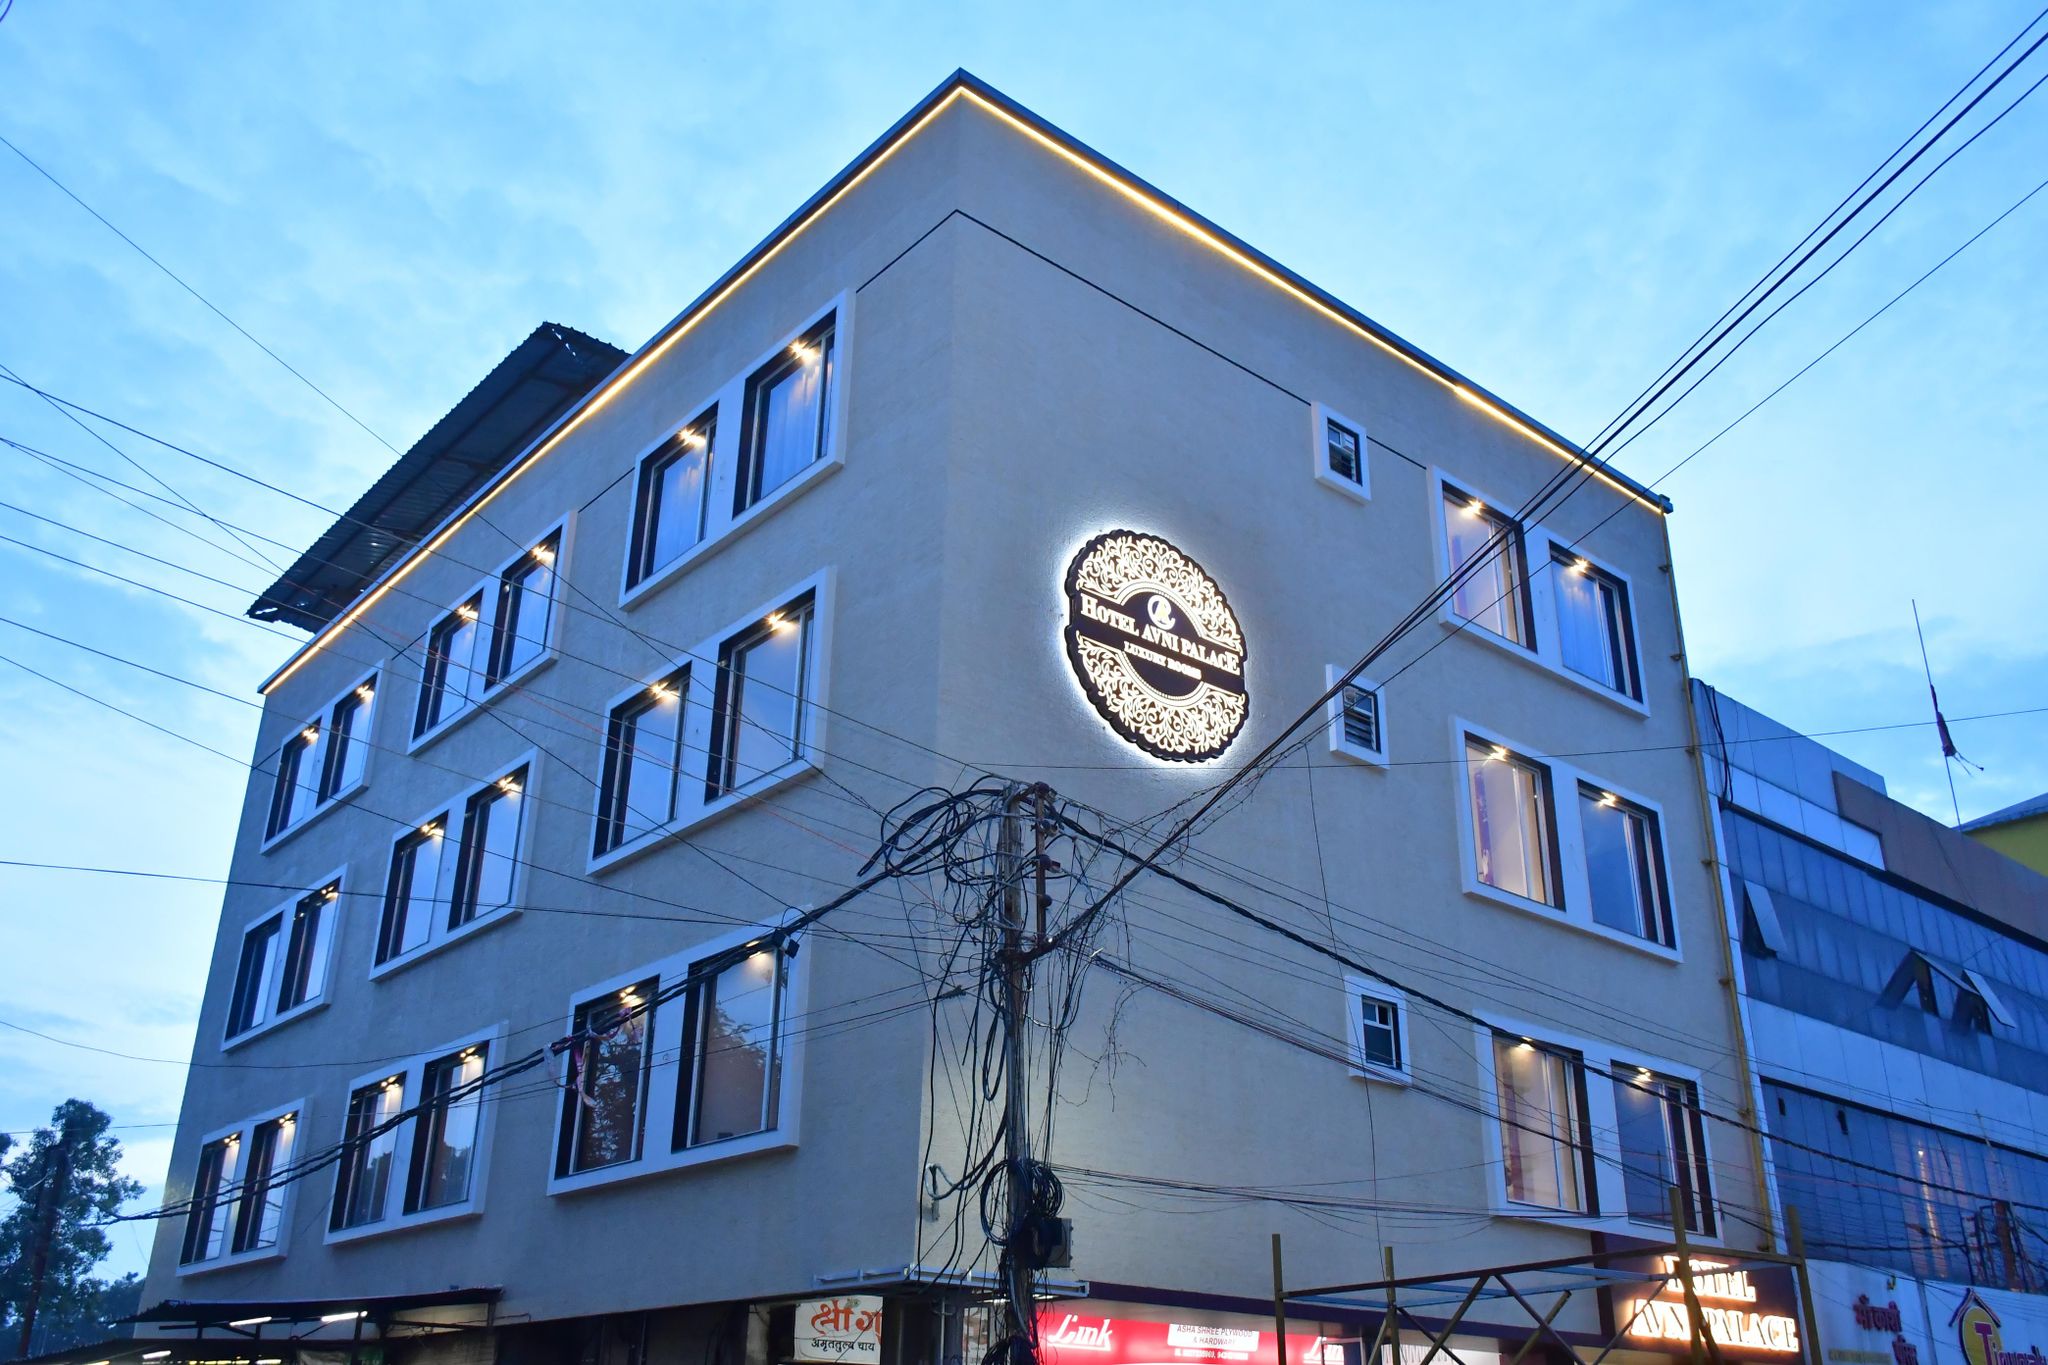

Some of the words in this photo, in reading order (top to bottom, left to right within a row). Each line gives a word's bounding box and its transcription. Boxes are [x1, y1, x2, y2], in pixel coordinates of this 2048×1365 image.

[1080, 592, 1140, 636] HOTEL
[1142, 624, 1180, 653] AVNI
[1180, 637, 1241, 676] PALACE
[1123, 640, 1167, 667] LUXURY
[1167, 657, 1202, 680] ROOMS
[857, 1341, 876, 1352] चाय
[1046, 1314, 1113, 1351] Link
[1176, 1325, 1196, 1333] ASHA
